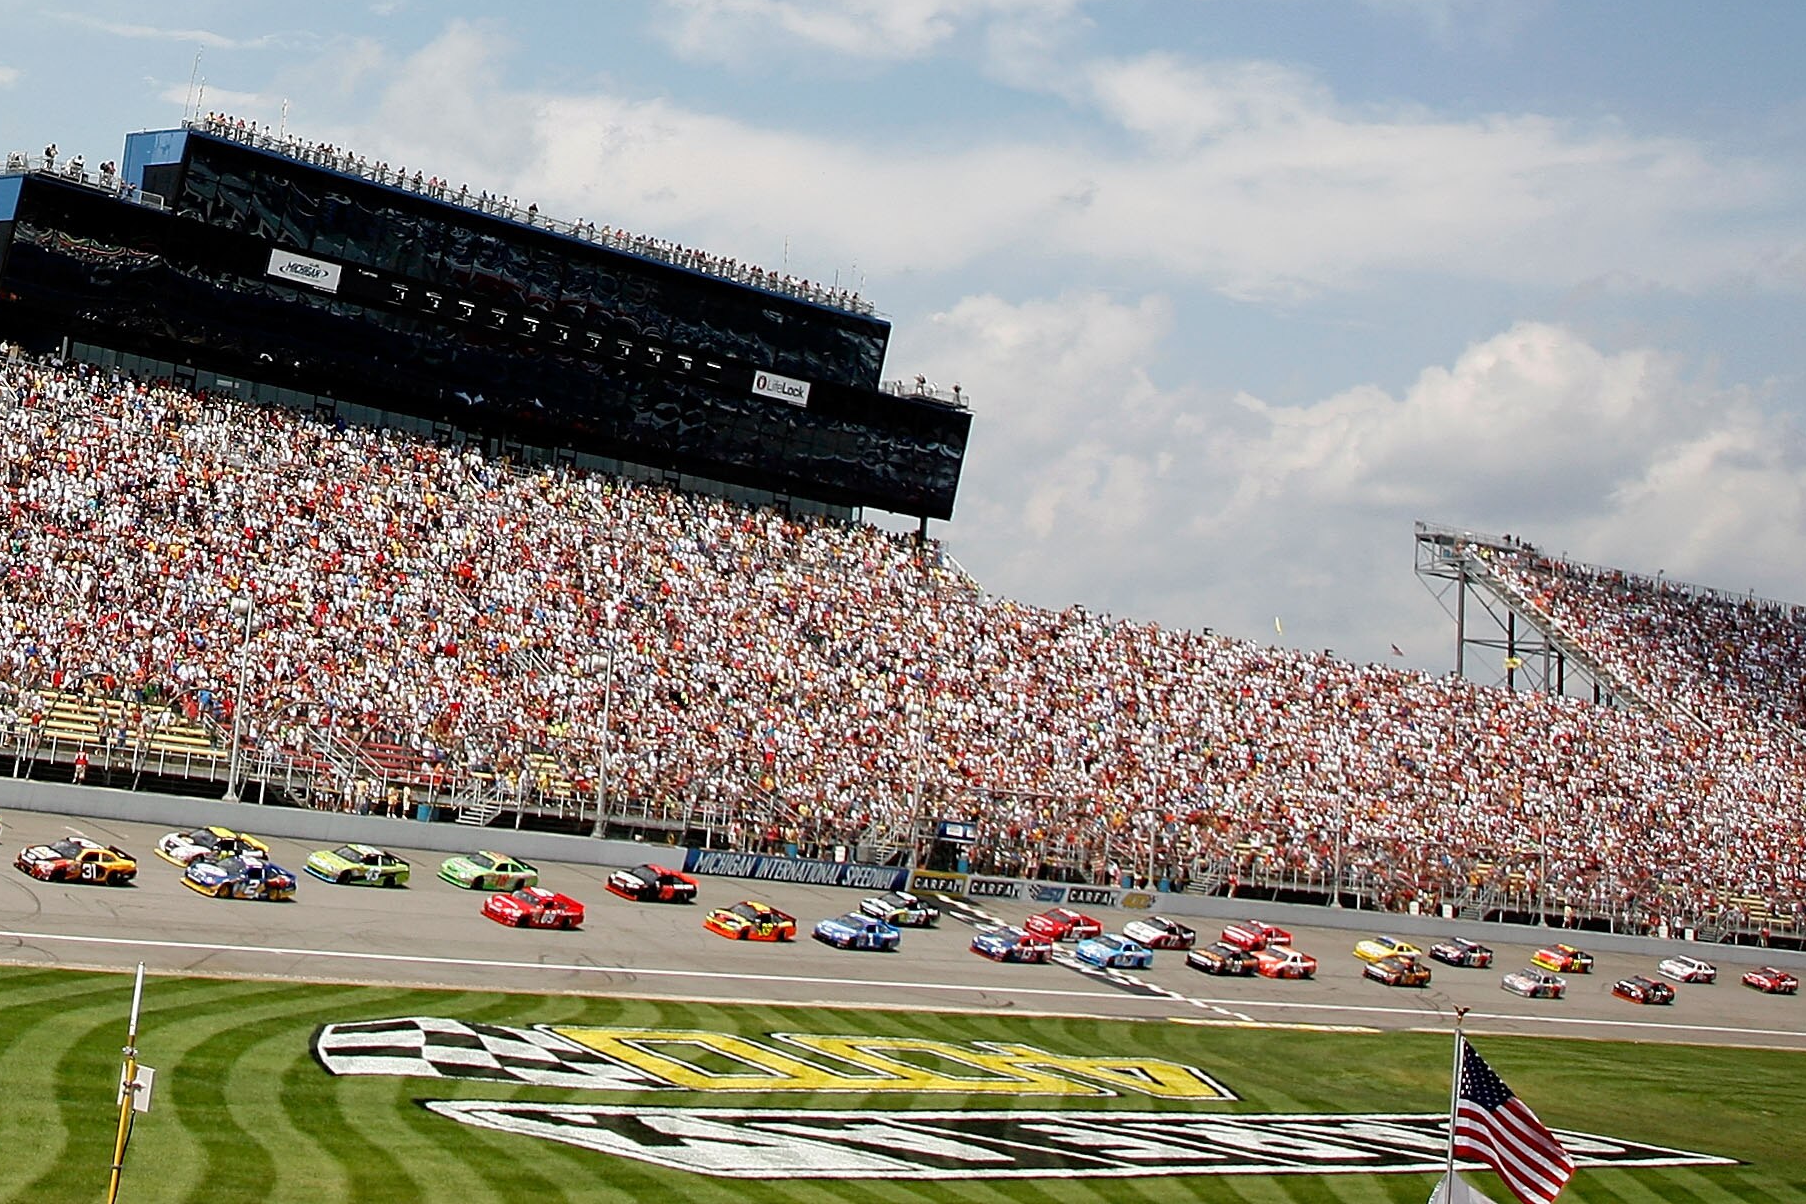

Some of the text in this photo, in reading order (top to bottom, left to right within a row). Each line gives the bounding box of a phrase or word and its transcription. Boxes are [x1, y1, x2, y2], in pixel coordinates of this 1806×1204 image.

[82, 863, 97, 879] 31
[693, 852, 900, 889] MICHIGAN INTERNATIONAL SPEEDWAY
[244, 879, 260, 894] 2
[913, 877, 964, 894] CARFAX
[971, 879, 1022, 898] CARFAX
[1069, 889, 1118, 907] CARFAX
[538, 1024, 1240, 1101] 400
